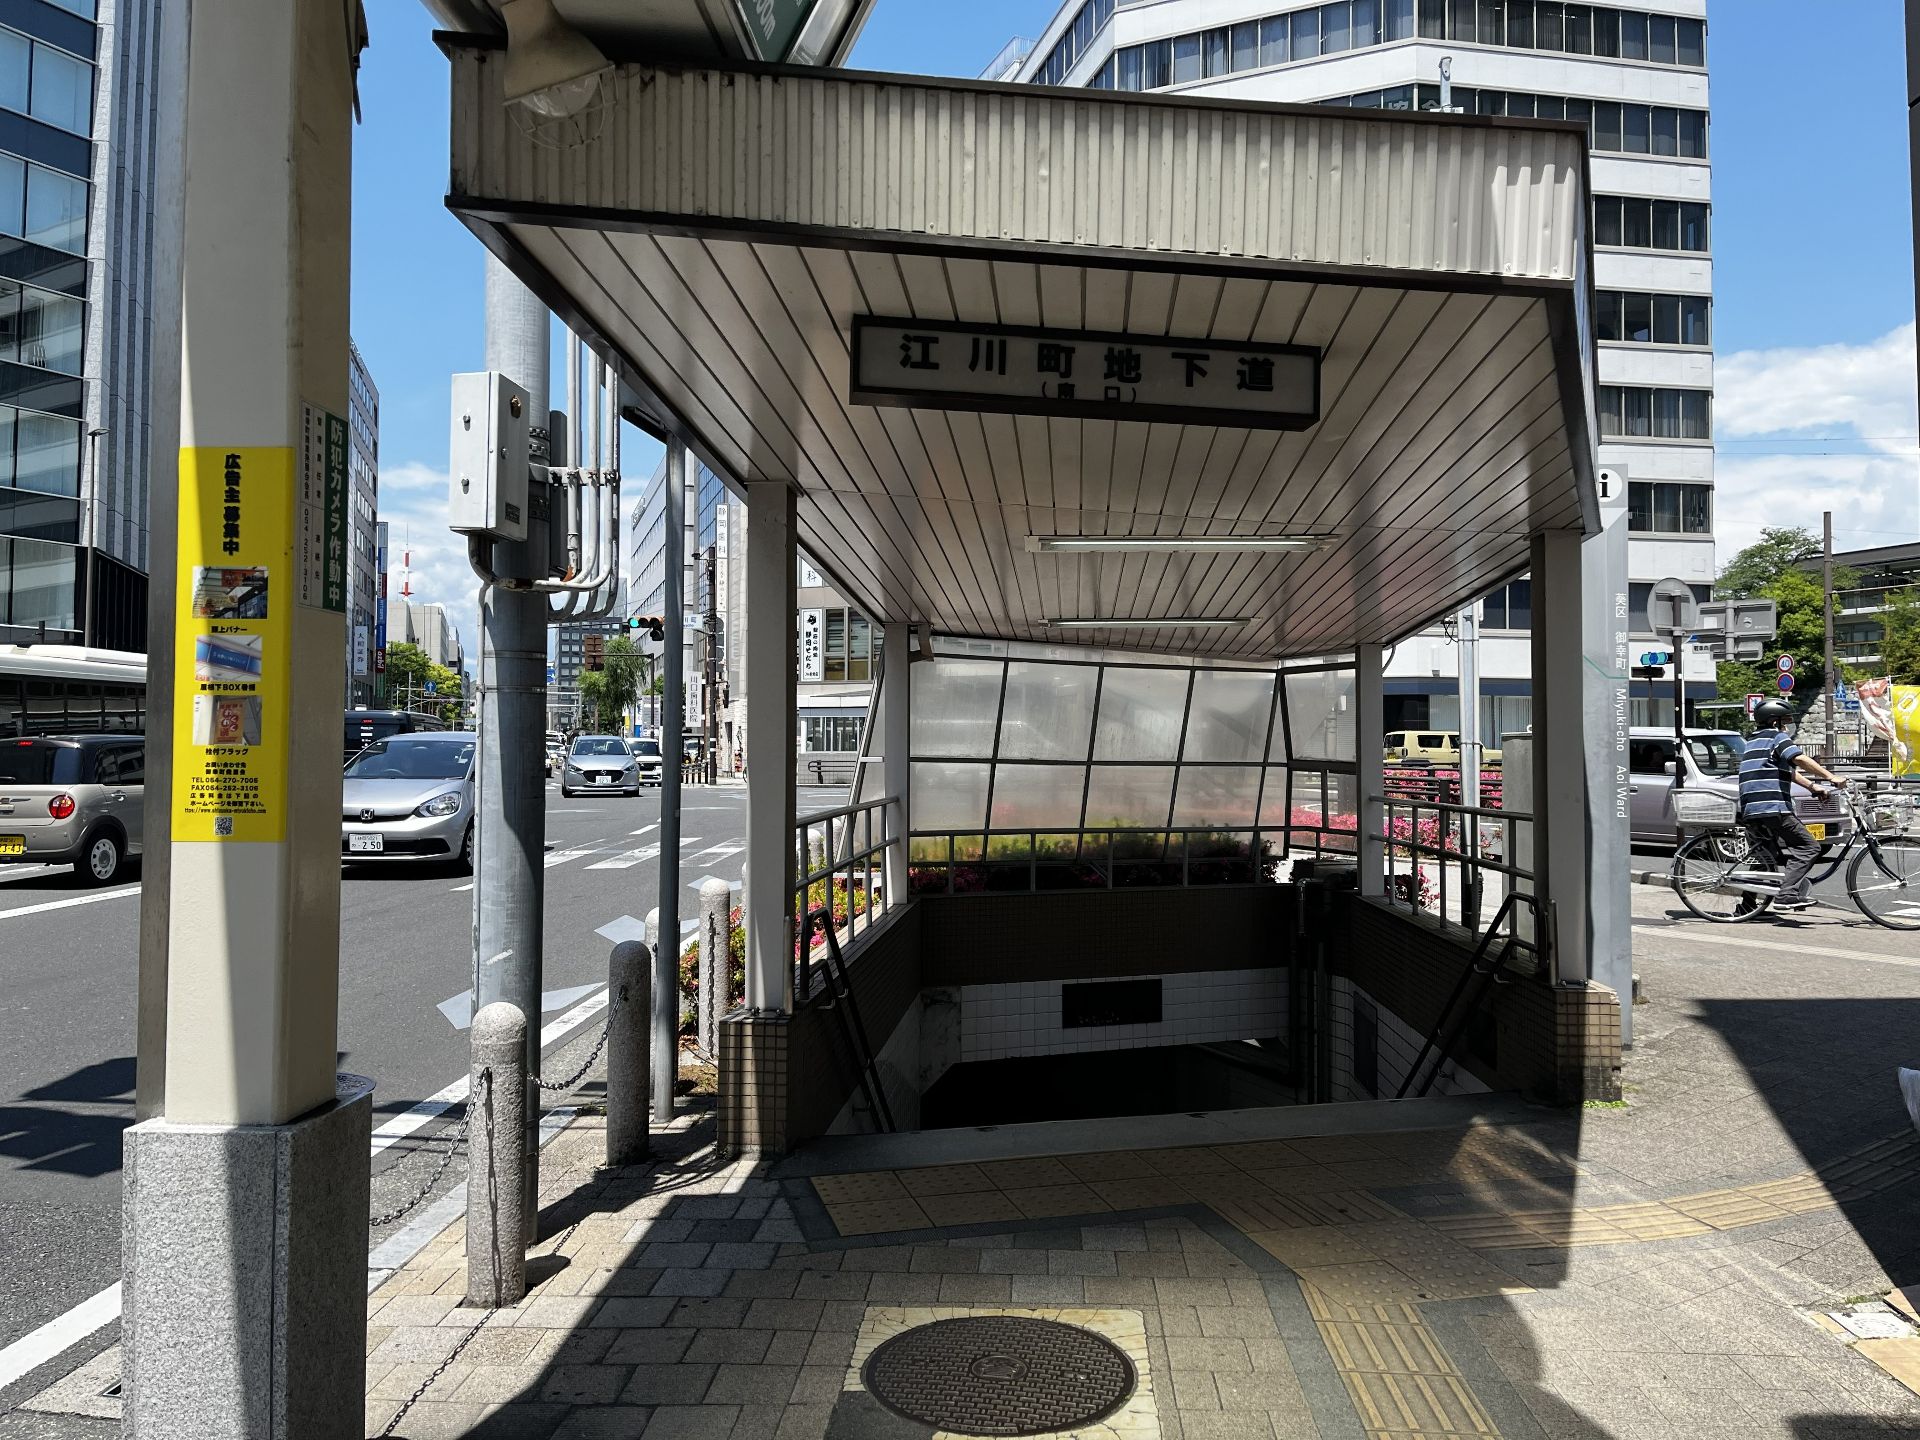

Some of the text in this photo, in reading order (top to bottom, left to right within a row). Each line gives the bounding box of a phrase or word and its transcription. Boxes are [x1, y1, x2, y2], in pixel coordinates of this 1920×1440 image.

[899, 333, 1275, 393] 江川町地下道
[223, 453, 242, 556] 広告主募集中
[329, 419, 343, 607] 防犯カメラ作動中
[377, 651, 385, 669] azbil
[1615, 592, 1627, 670] 葵区 御幸町
[1616, 688, 1627, 818] Miyuki-cho Aoi Ward
